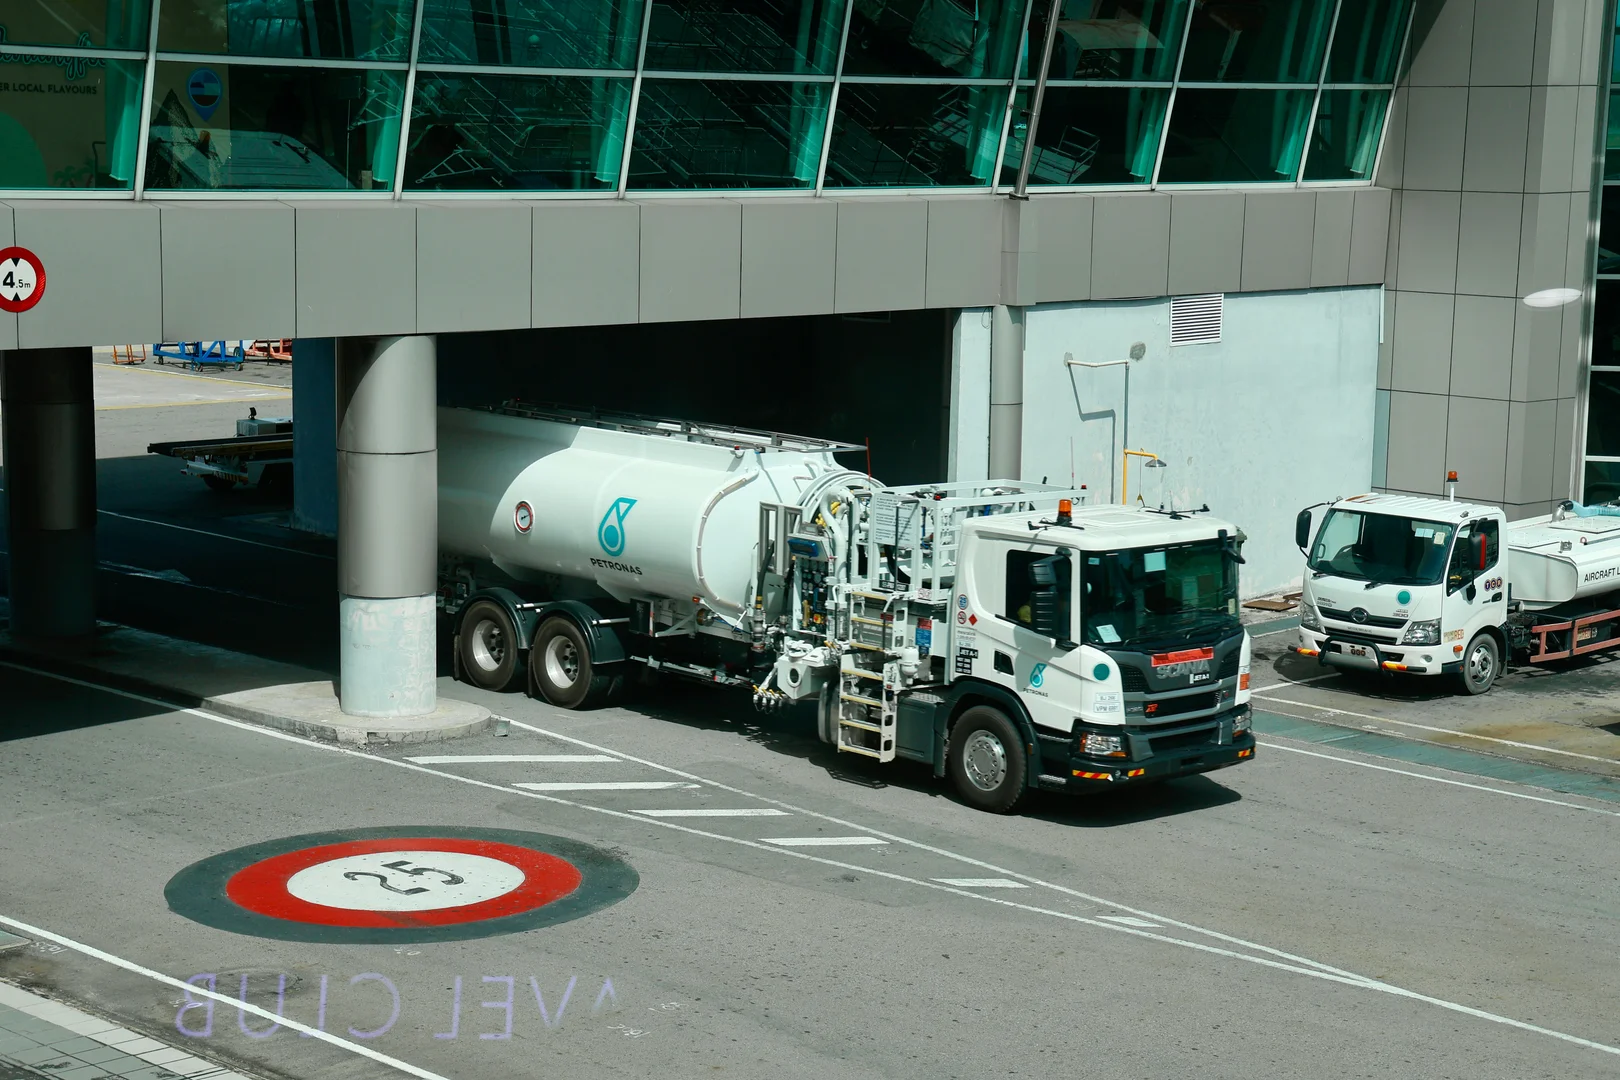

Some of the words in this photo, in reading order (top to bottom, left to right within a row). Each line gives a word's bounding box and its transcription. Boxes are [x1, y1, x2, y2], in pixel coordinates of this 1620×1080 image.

[12, 83, 45, 93] LOCAL
[48, 84, 97, 95] FLAVOURS
[589, 557, 643, 575] PETRONAS
[1583, 568, 1616, 582] AIRCRAFT
[1156, 660, 1210, 679] SCANIA
[1023, 688, 1048, 697] PETRONAS
[343, 860, 464, 896] 25
